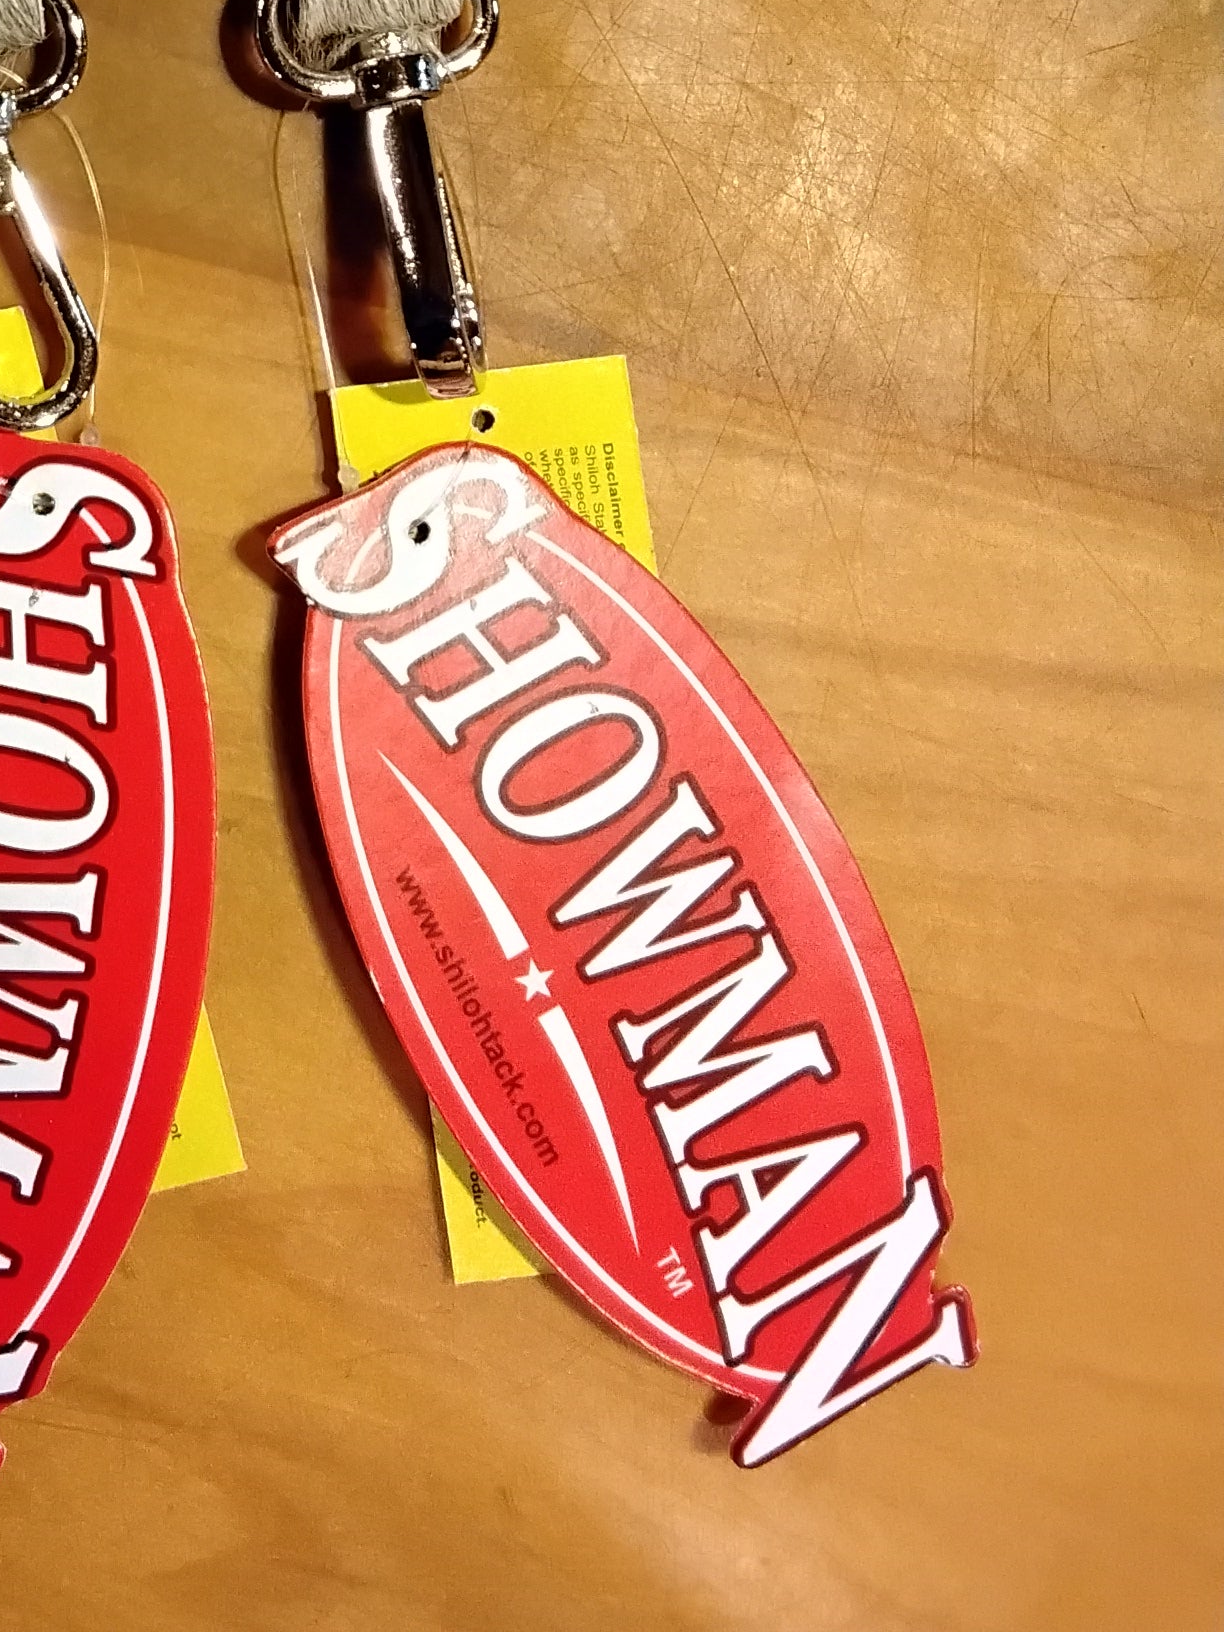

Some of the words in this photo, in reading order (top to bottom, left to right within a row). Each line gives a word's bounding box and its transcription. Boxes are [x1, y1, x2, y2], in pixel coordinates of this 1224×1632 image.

[569, 446, 580, 465] as
[584, 444, 600, 495] Shiloh
[602, 442, 625, 538] Disclaimer
[272, 448, 968, 1470] SHOWMAN
[395, 863, 560, 1169] www.shilohtack.com
[655, 1247, 692, 1299] TM
